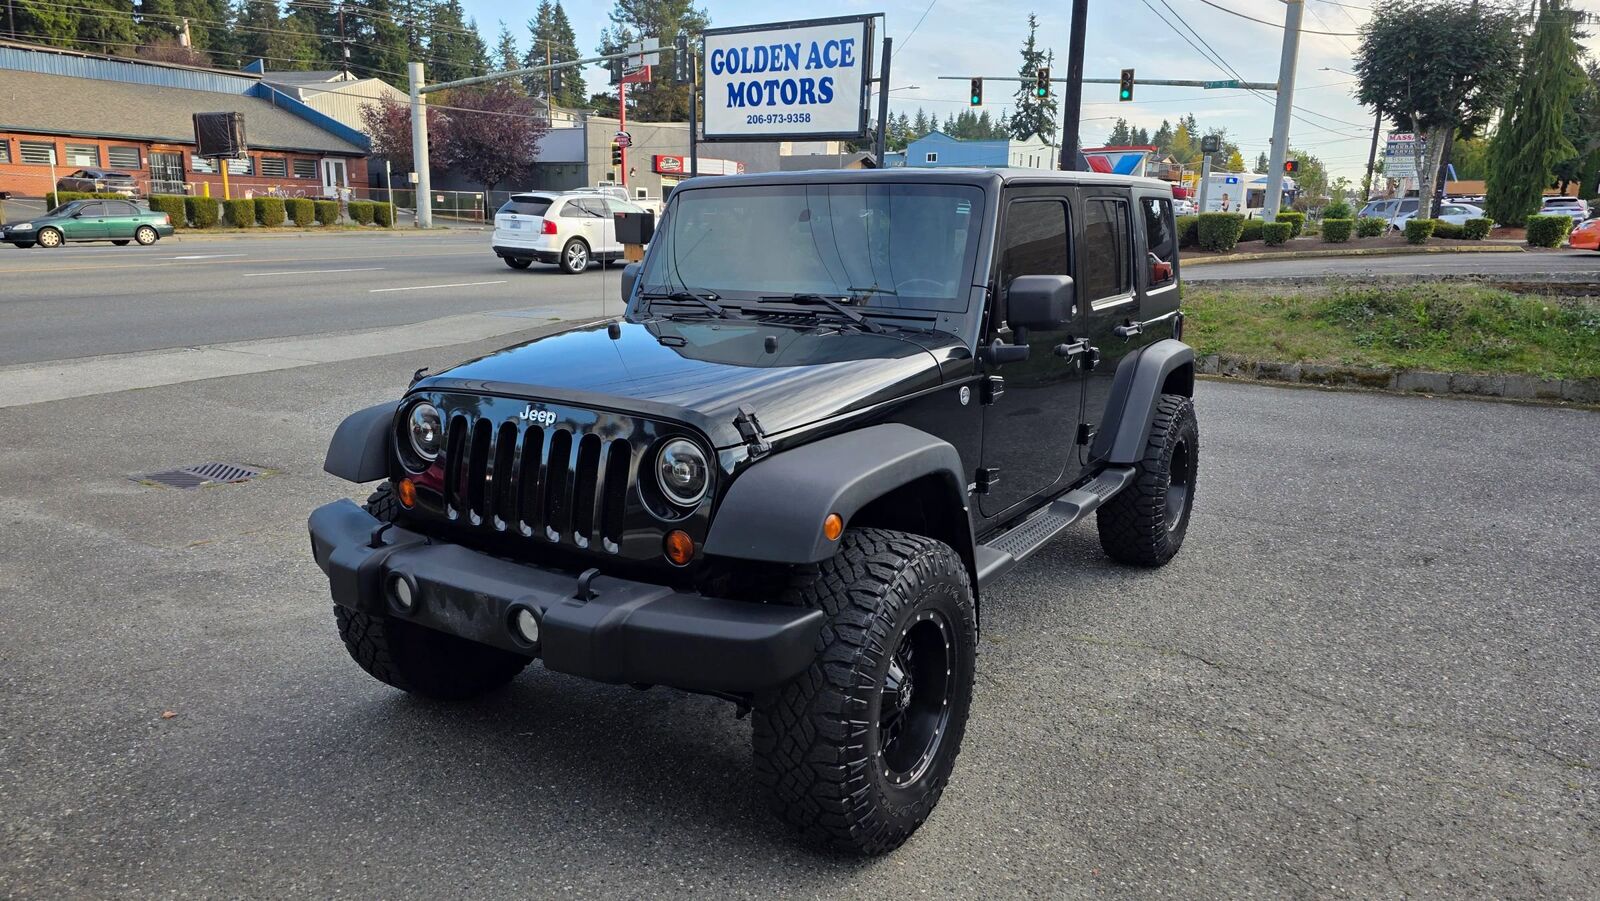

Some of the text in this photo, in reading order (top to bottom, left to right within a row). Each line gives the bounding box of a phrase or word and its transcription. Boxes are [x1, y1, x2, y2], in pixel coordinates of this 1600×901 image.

[710, 38, 855, 75] GOLDEN ACE
[727, 77, 833, 108] MOTORS
[746, 113, 811, 125] 206-973-9358
[519, 405, 556, 426] Jeep
